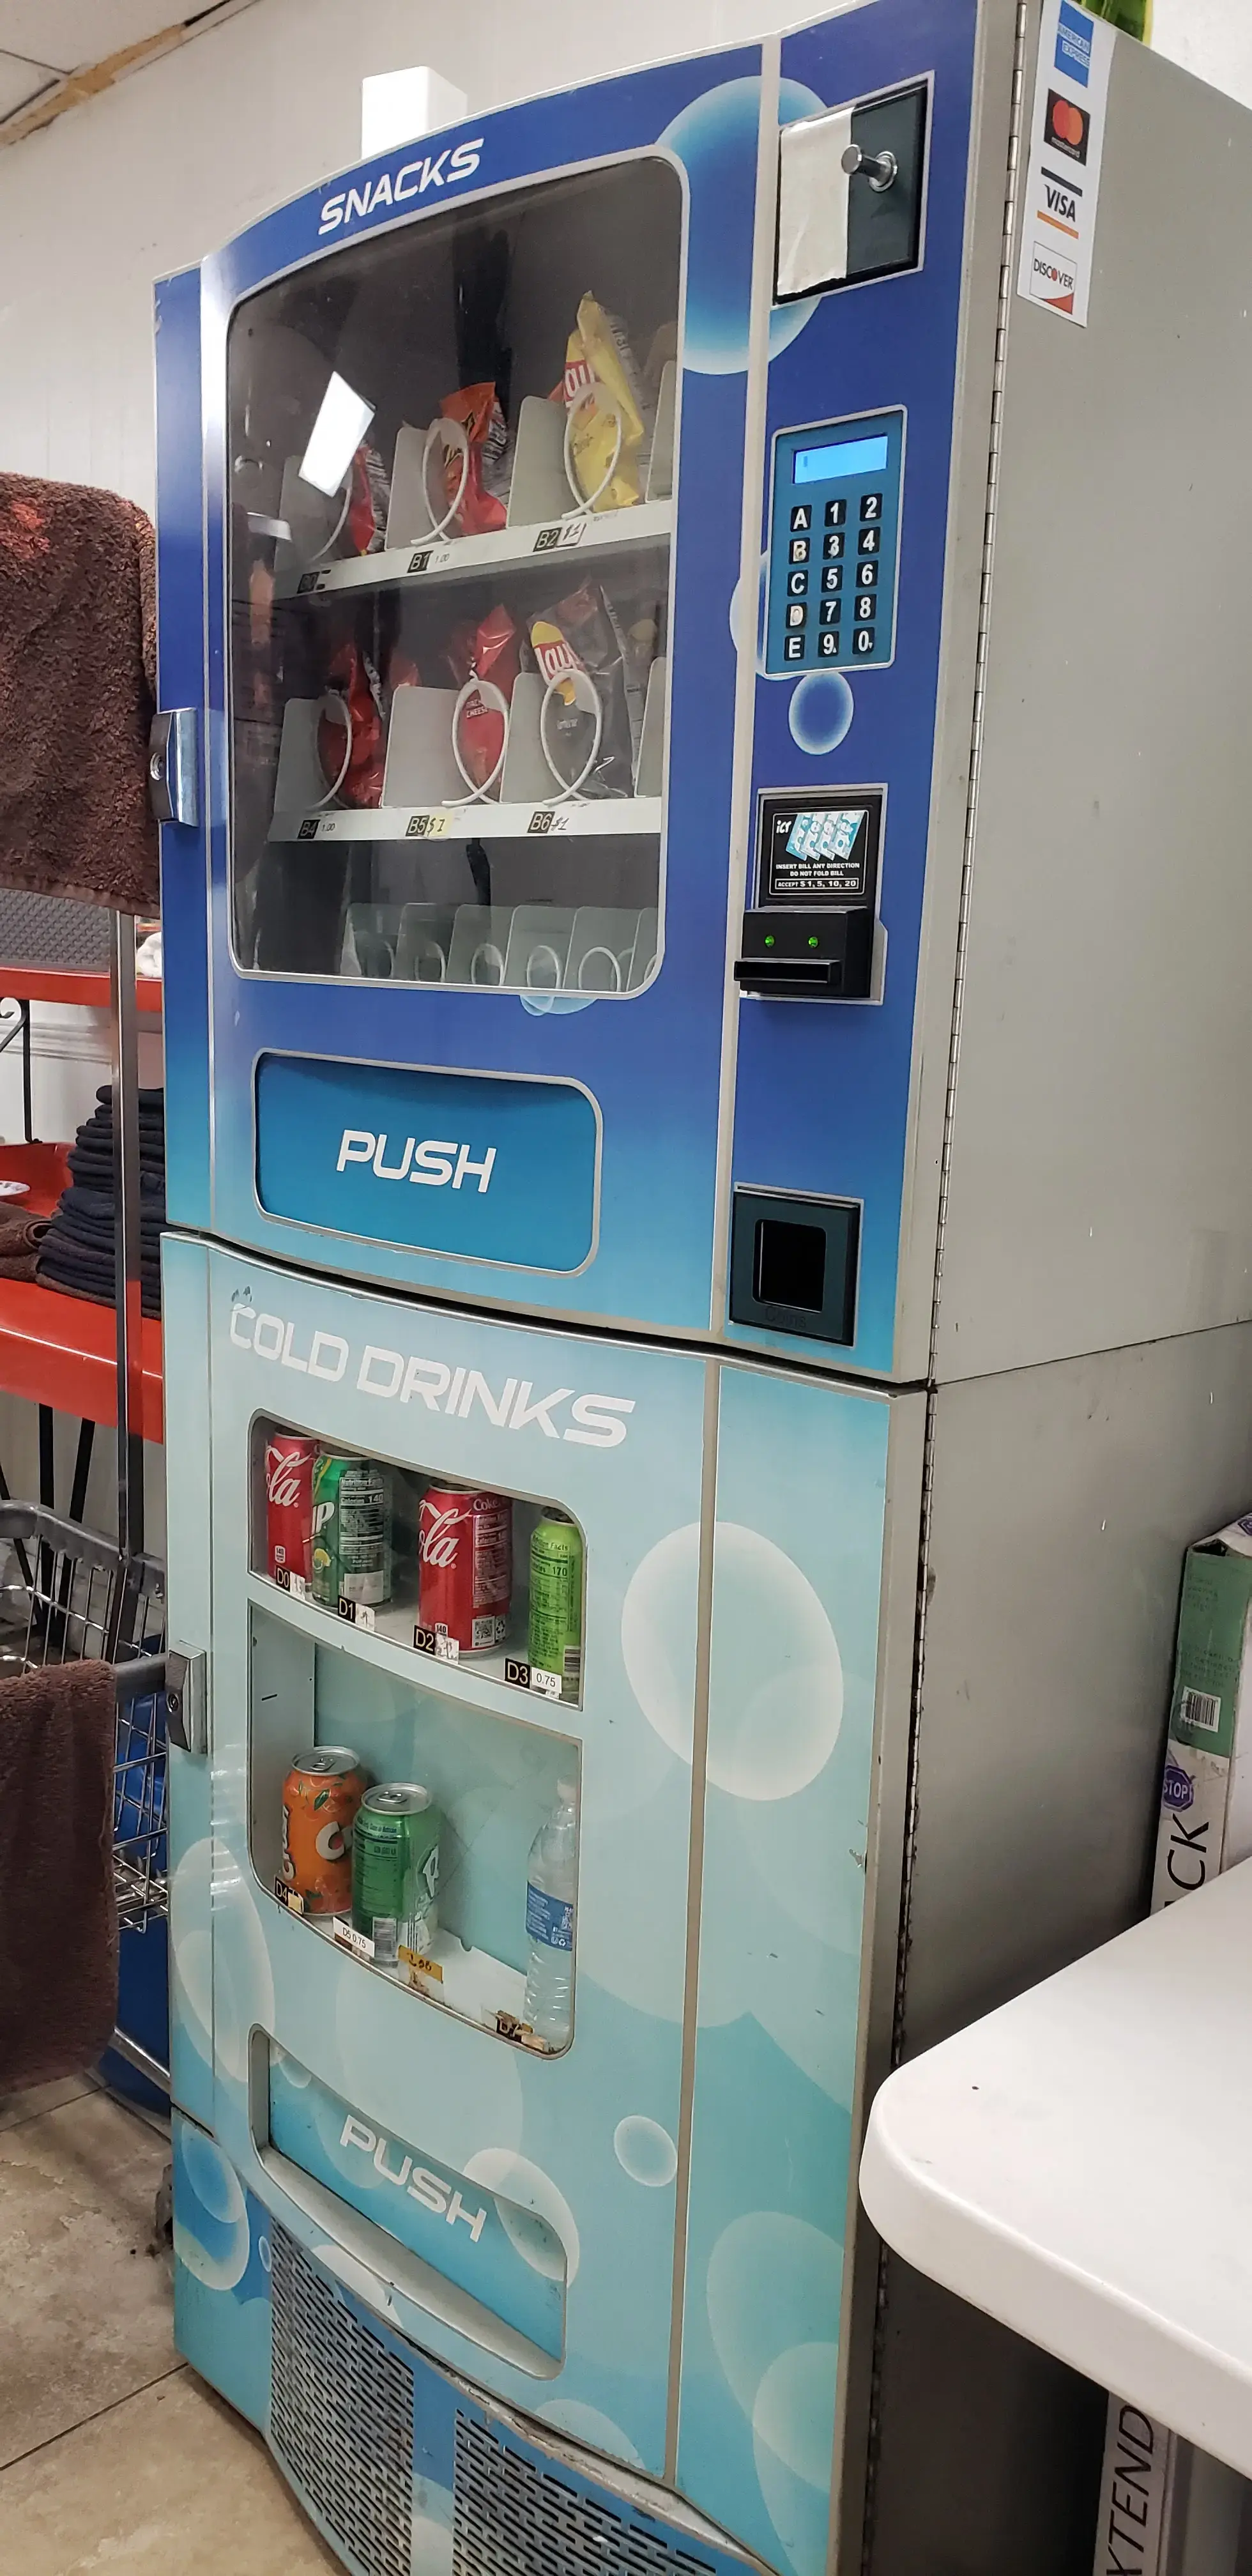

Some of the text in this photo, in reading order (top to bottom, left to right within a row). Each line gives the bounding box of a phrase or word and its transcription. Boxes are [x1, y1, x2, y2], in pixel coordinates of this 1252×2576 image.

[318, 138, 484, 235] SNACKS
[1044, 184, 1076, 222] VISA
[1034, 258, 1074, 290] DISCOVER
[793, 496, 878, 530] A 1 2
[537, 530, 560, 548] B2
[793, 530, 876, 563] B 3 4
[411, 551, 431, 570] B1
[791, 563, 874, 594] C 5 6
[790, 596, 871, 627] D 7 8
[788, 631, 869, 659] E 9 0
[300, 822, 316, 836] B4
[407, 817, 427, 834] B5
[530, 813, 552, 831] B6
[336, 1129, 497, 1193] PUSH
[229, 1303, 636, 1448] COLD DRINKS
[368, 1494, 383, 1503] 140
[473, 1498, 498, 1512] Coke
[550, 1542, 569, 1551] Facts
[277, 1568, 289, 1588] D0
[552, 1566, 568, 1577] 170
[339, 1598, 353, 1620] D1
[415, 1629, 434, 1652] D2
[436, 1624, 447, 1634] 140
[507, 1661, 556, 1688] D3 0.75
[1163, 1779, 1189, 1800] STOP
[276, 1880, 288, 1903] D4
[342, 1926, 367, 1949] D5 0.75
[340, 2114, 487, 2243] PUSH
